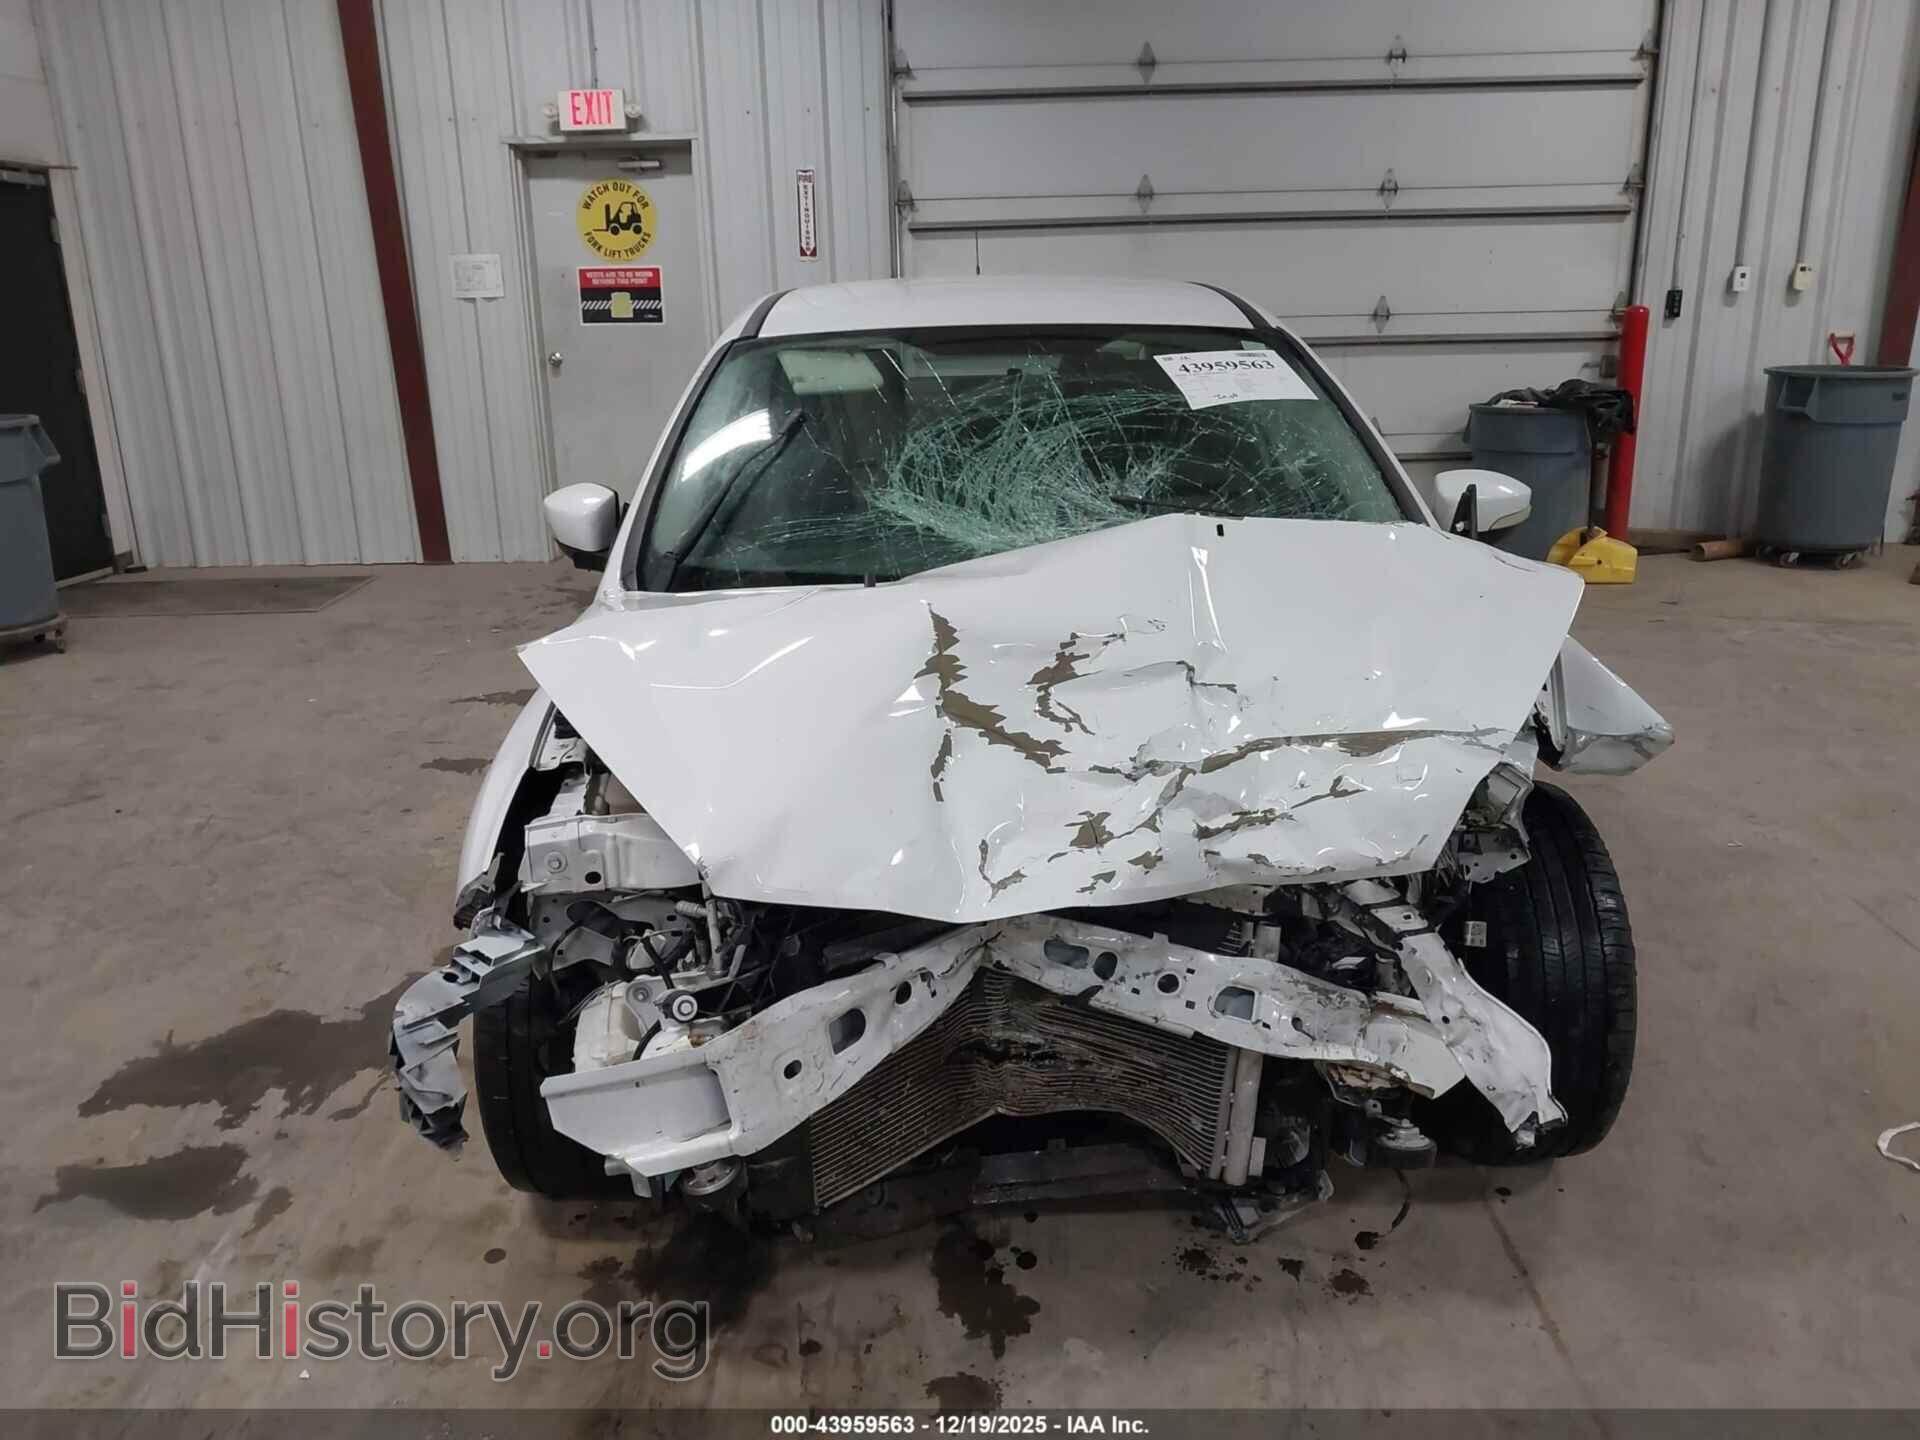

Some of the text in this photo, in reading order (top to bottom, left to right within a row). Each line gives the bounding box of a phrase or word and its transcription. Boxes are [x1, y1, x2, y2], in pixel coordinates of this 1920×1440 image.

[571, 91, 613, 126] EXIT
[582, 181, 650, 210] WATCH OUT FOR
[604, 247, 622, 258] LIFT
[624, 231, 652, 257] TRUCKS
[1178, 359, 1275, 374] 43959563
